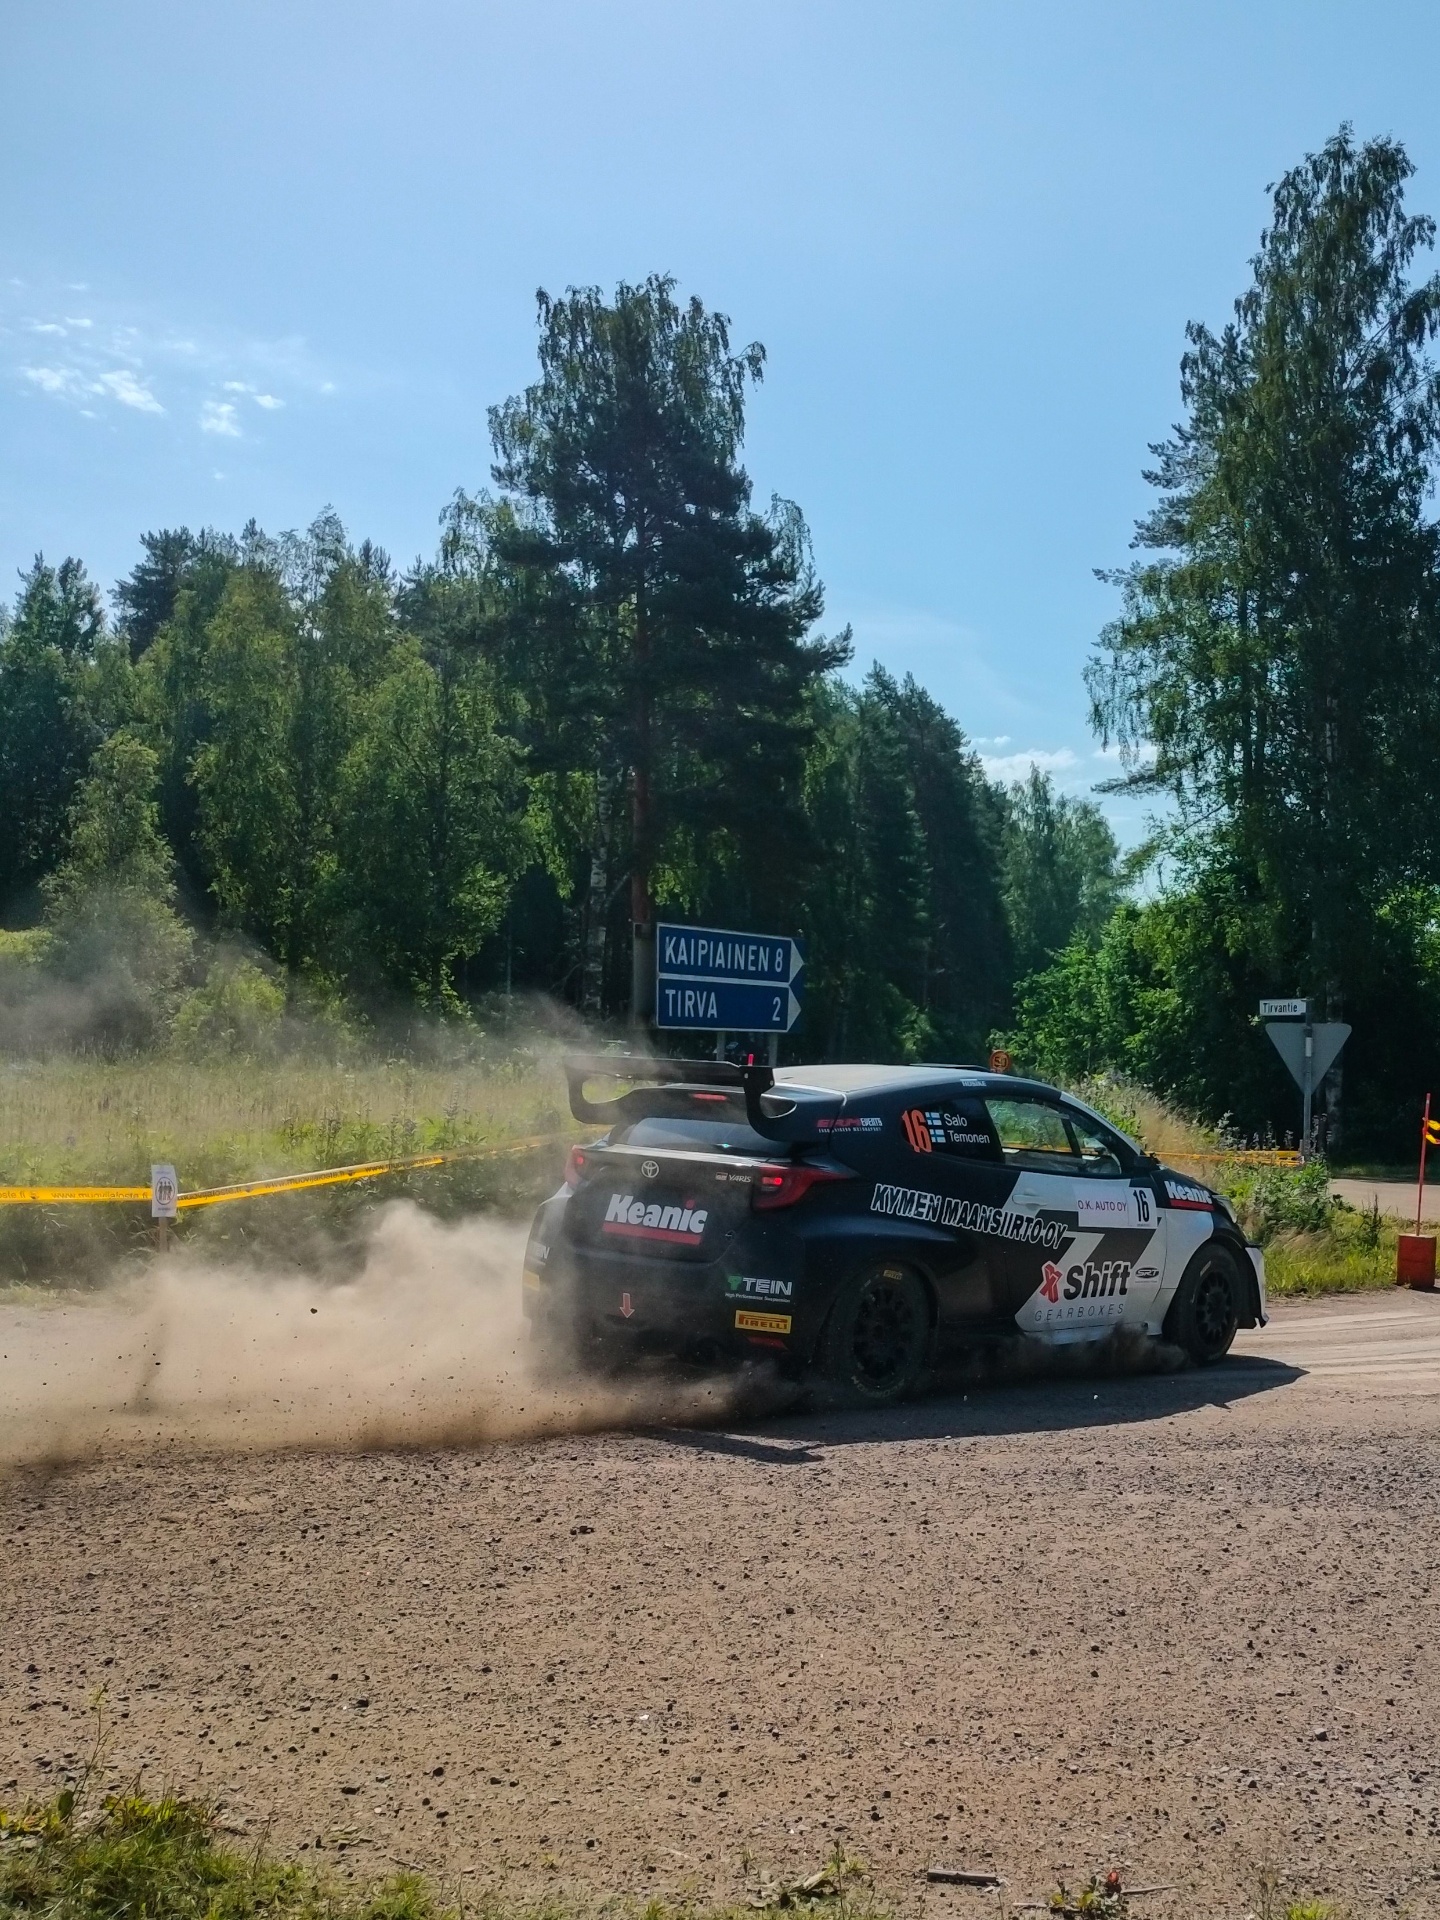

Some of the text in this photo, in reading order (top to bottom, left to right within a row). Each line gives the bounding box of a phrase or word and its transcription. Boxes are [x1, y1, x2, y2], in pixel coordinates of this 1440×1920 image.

[665, 936, 783, 973] KAIPIAINEN 8
[665, 989, 781, 1021] TIRVA 2
[1263, 1002, 1298, 1013] Tirvantie
[994, 1056, 1007, 1068] 50
[943, 1113, 967, 1127] Salo
[902, 1109, 932, 1153] 16
[948, 1130, 990, 1144] Temonen
[729, 1174, 752, 1183] YARIS
[1163, 1180, 1213, 1204] Keanic
[870, 1183, 942, 1223] KYMEN
[1078, 1200, 1127, 1212] O.K. AUTO OY
[1132, 1189, 1150, 1222] 16
[604, 1194, 708, 1234] Keanic
[742, 1277, 793, 1295] TEIN
[1035, 1303, 1124, 1321] GEARBOXES
[738, 1313, 788, 1330] PIRELLI
